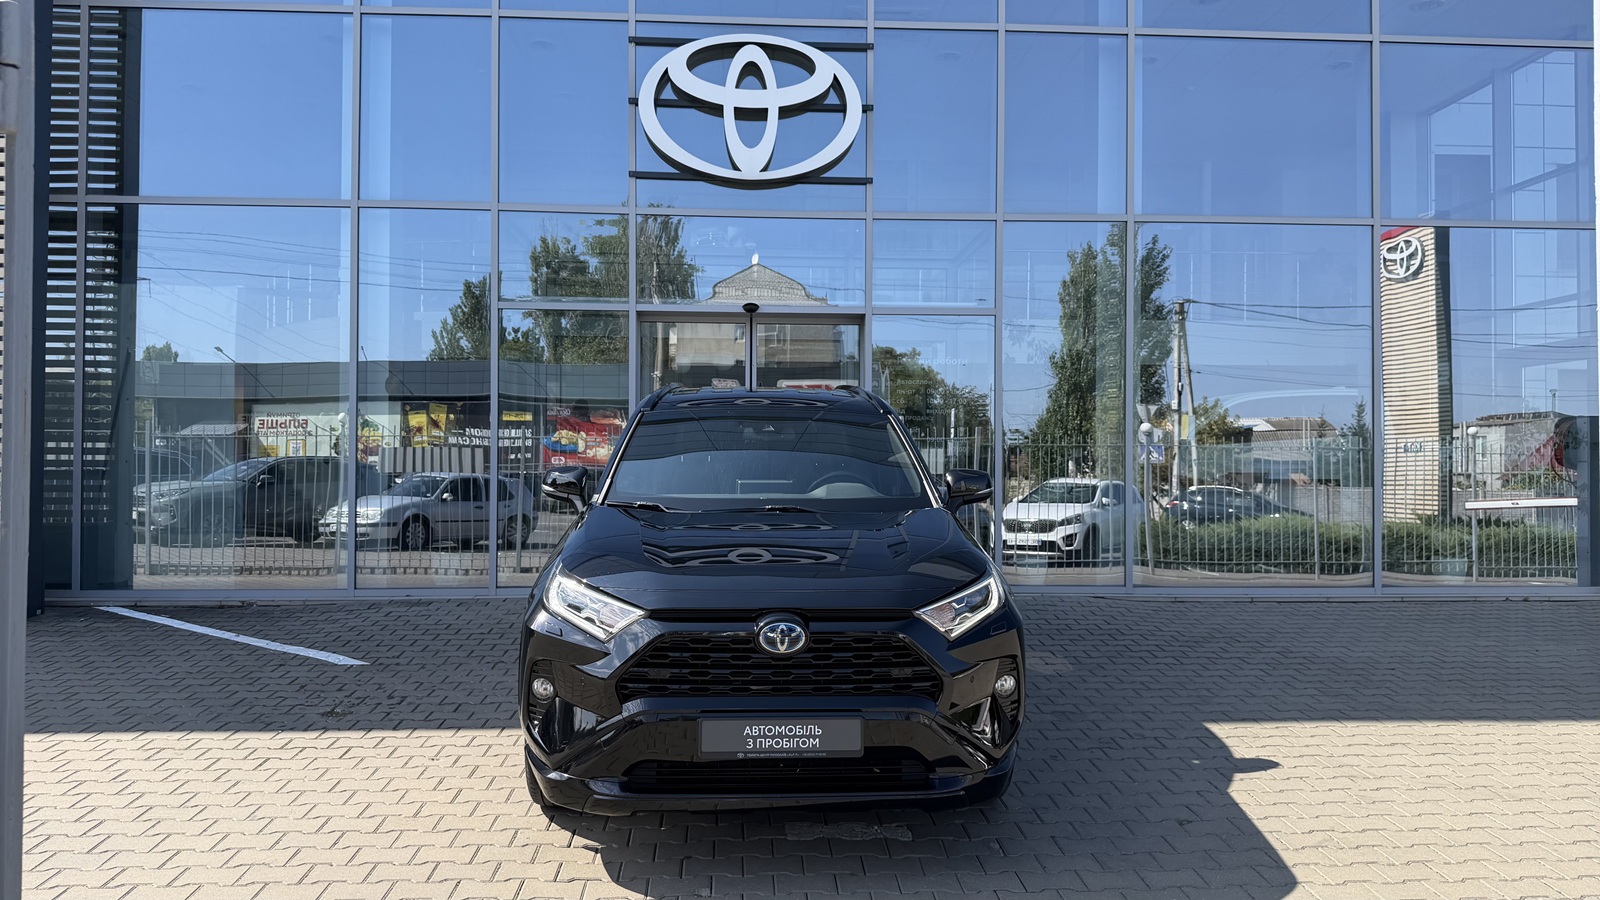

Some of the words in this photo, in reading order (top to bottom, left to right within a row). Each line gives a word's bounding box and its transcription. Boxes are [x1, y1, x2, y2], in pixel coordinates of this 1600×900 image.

[933, 356, 968, 366] роботи
[743, 725, 823, 736] АВТОМОБІЛЬ
[746, 739, 754, 749] З
[756, 738, 820, 749] ПРОБІГОМ
